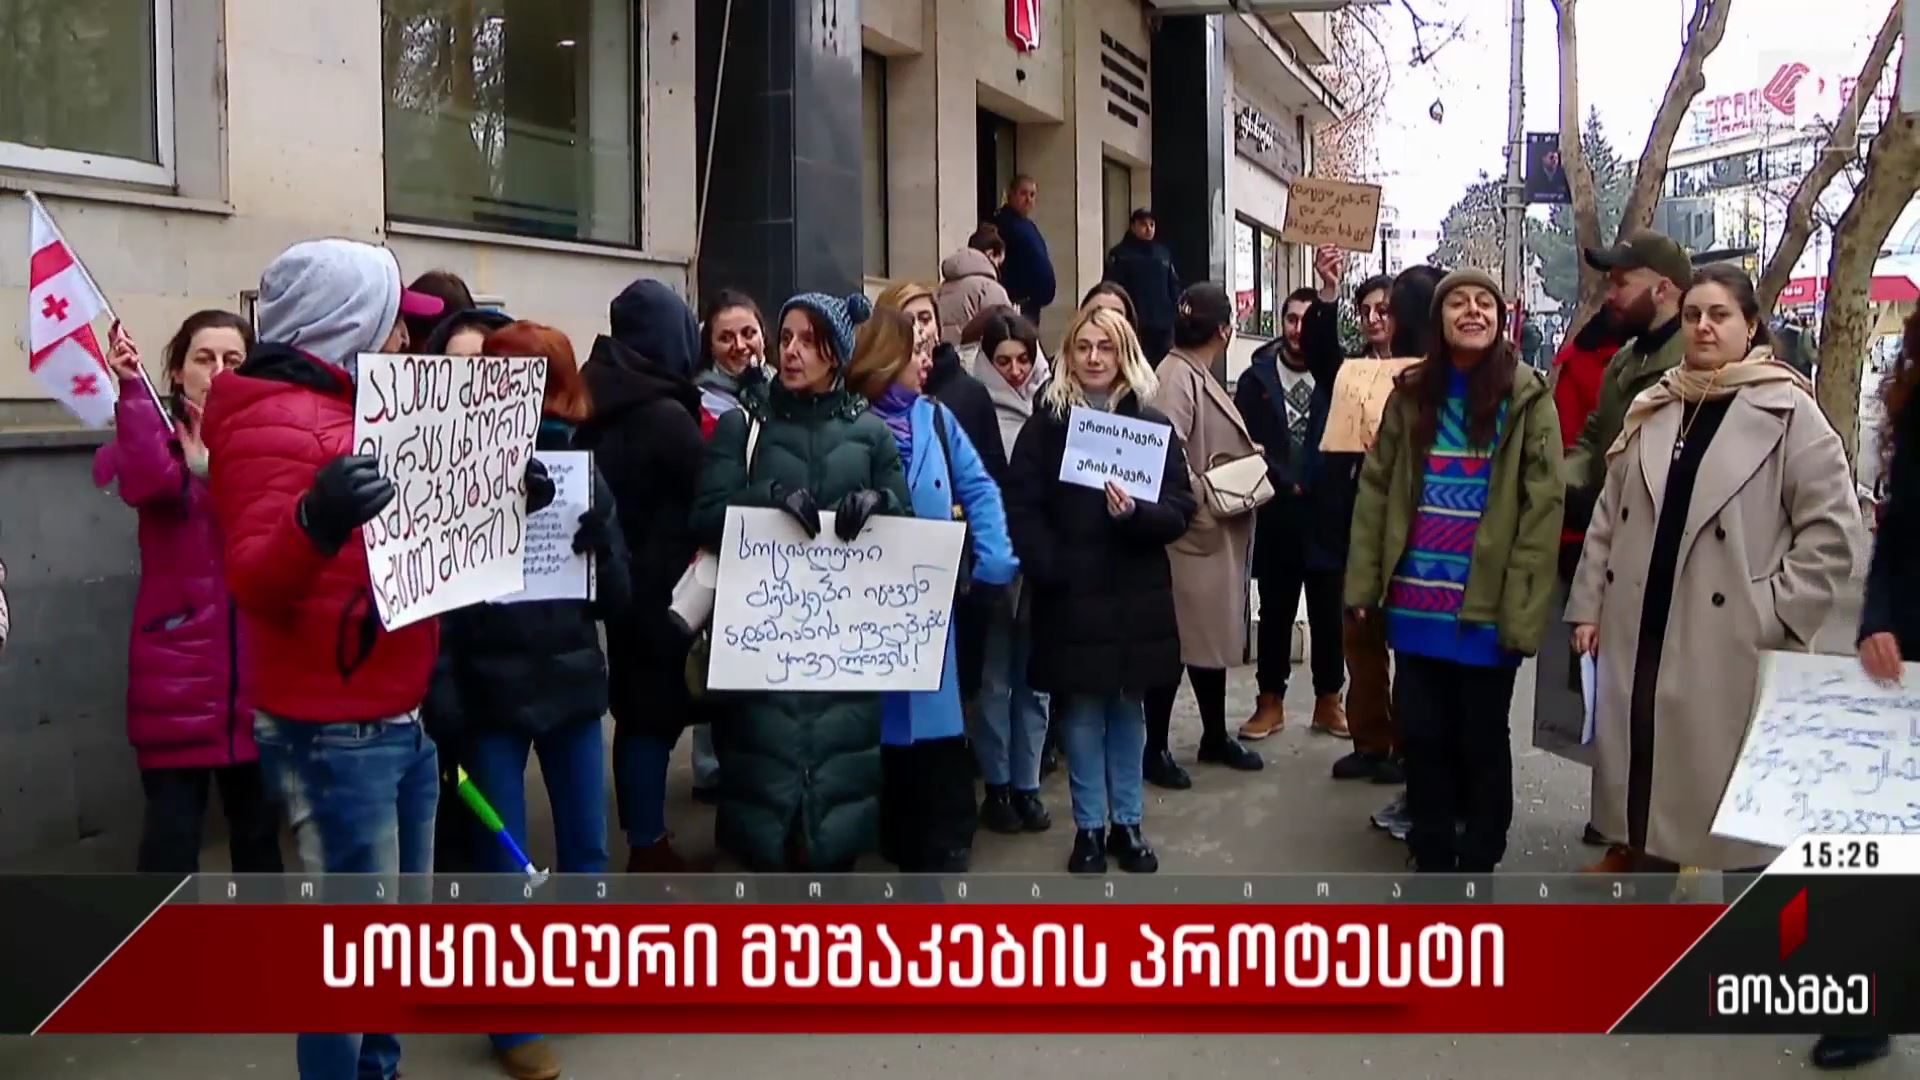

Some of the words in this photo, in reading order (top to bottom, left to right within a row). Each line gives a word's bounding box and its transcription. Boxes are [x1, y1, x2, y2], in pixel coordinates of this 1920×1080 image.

[364, 356, 451, 423] აკეთე
[459, 357, 545, 408] მედგრად
[393, 424, 442, 480] რაც
[449, 397, 538, 467] სწორია
[1078, 420, 1119, 437] ერთის
[1121, 426, 1163, 447] ჩაგვრა
[1076, 458, 1108, 474] ერის
[1110, 463, 1152, 485] ჩაგვრა
[439, 501, 521, 581] შორია
[739, 515, 882, 580] სოციალური
[746, 574, 851, 621] მუშაკები
[864, 564, 948, 608] იცავენ
[725, 610, 840, 652] ადამიანის
